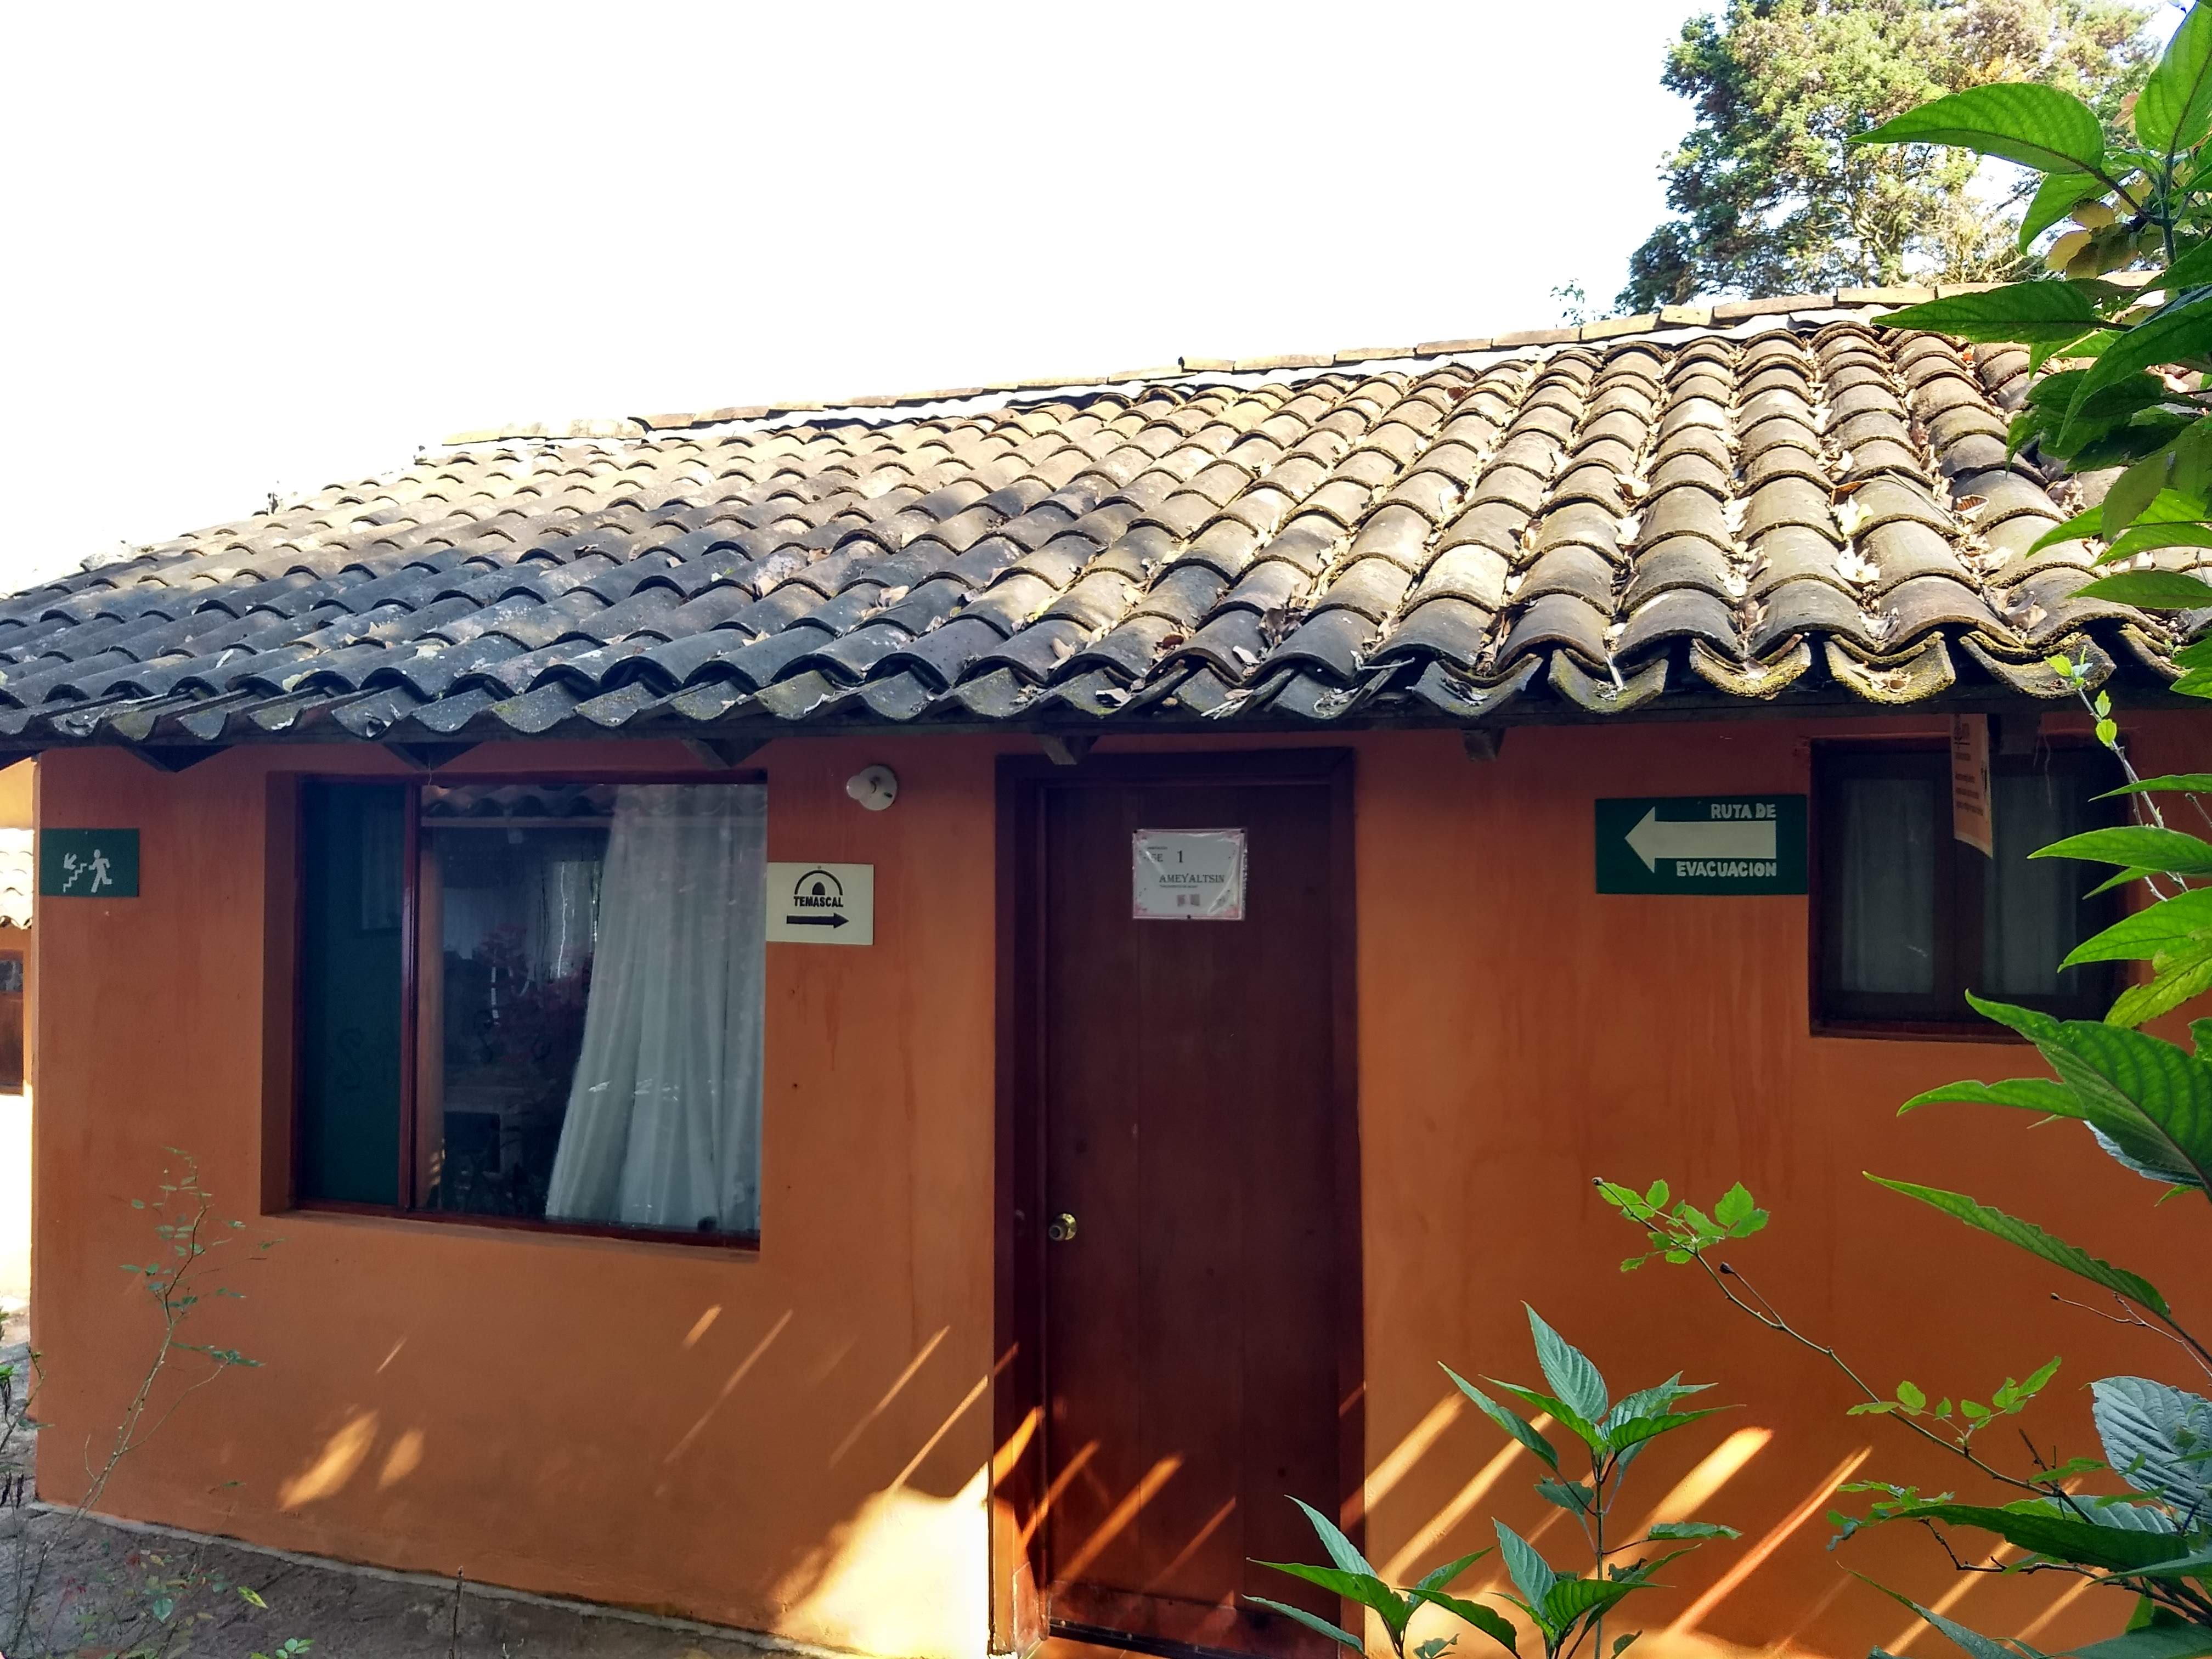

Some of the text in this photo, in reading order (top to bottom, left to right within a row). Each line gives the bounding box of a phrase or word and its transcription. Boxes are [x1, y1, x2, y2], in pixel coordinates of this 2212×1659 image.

[1711, 803, 1777, 819] RUTA DE
[1177, 850, 1183, 863] 1
[1676, 860, 1777, 877] EVACUACION
[1159, 873, 1224, 883] AMEYALTSIN
[794, 896, 843, 907] TEMASCAL
